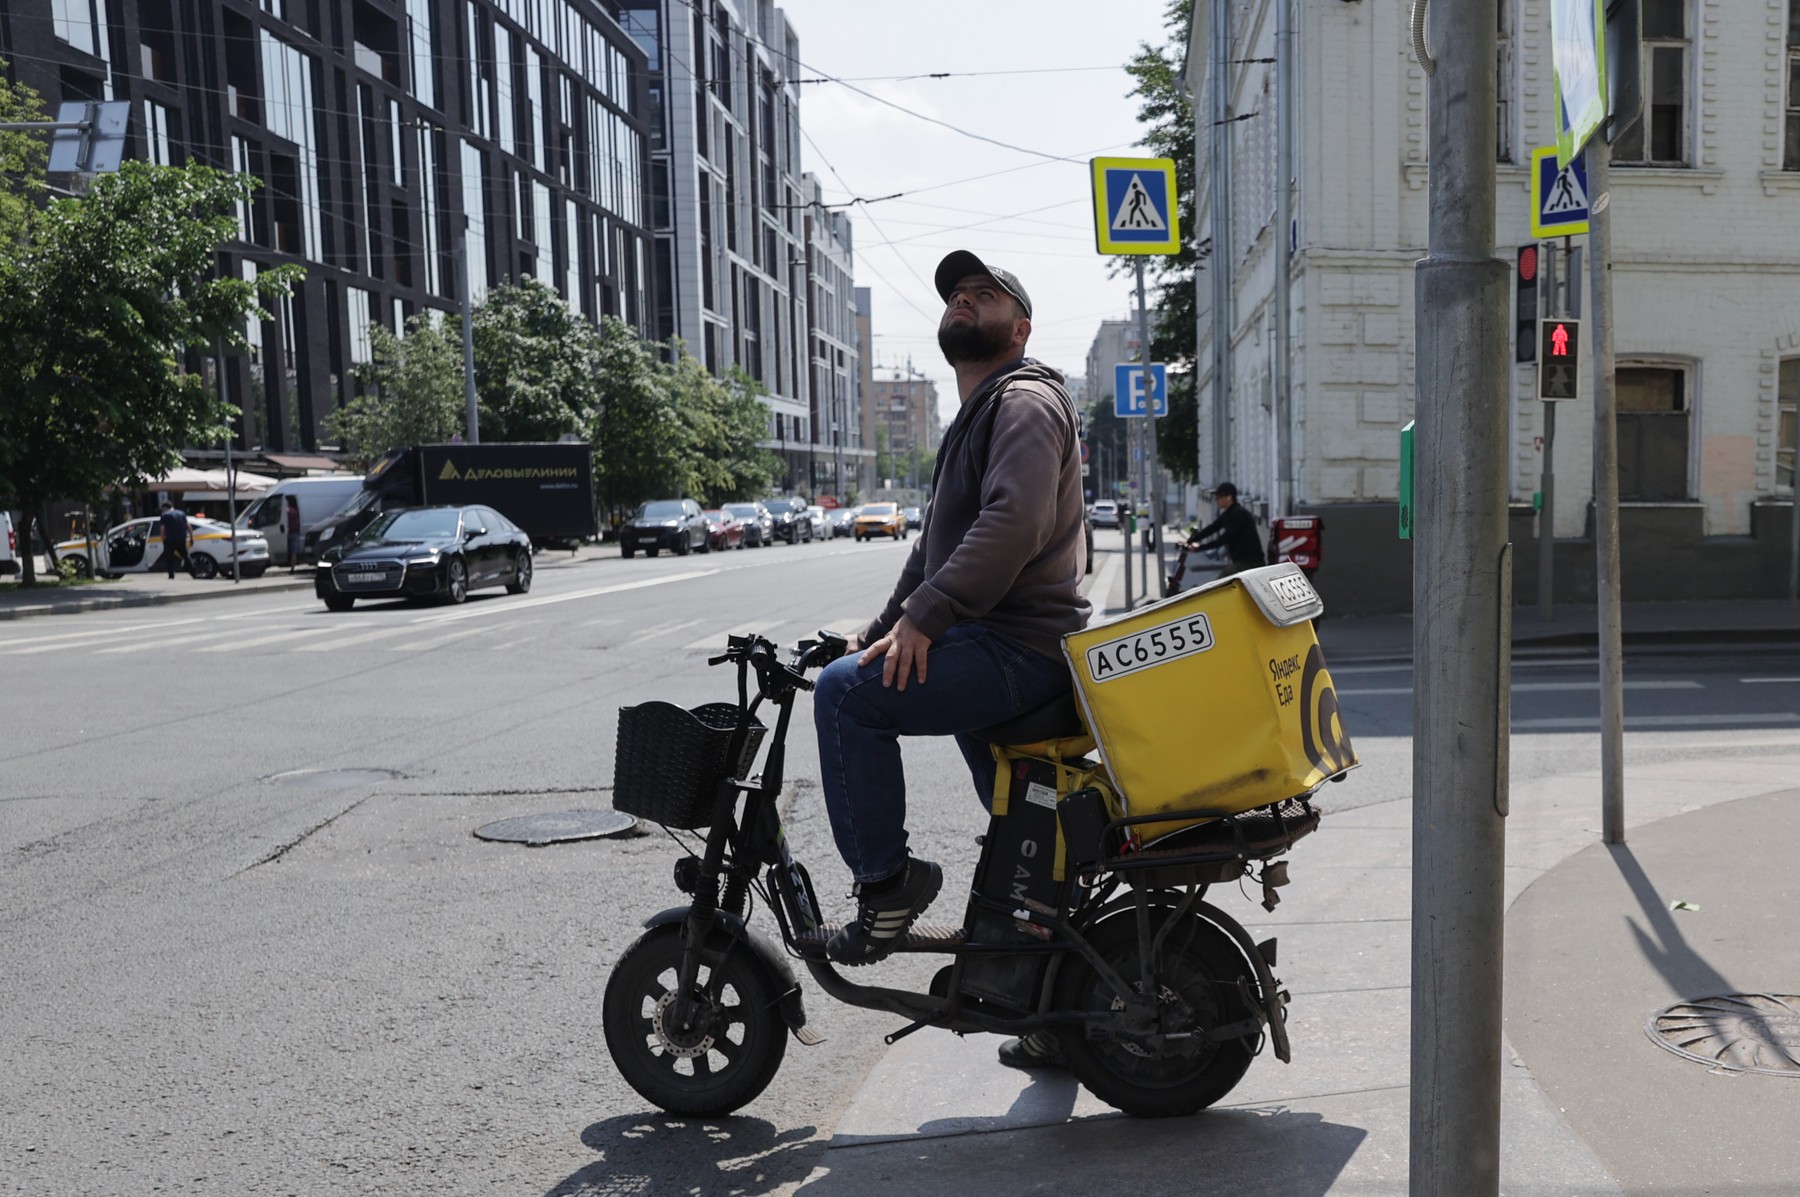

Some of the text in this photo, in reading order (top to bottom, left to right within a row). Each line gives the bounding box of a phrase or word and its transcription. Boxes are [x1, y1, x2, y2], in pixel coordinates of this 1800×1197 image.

[1097, 620, 1205, 676] AC6555
[1269, 653, 1301, 681] Яндекс
[1275, 684, 1294, 707] Еда
